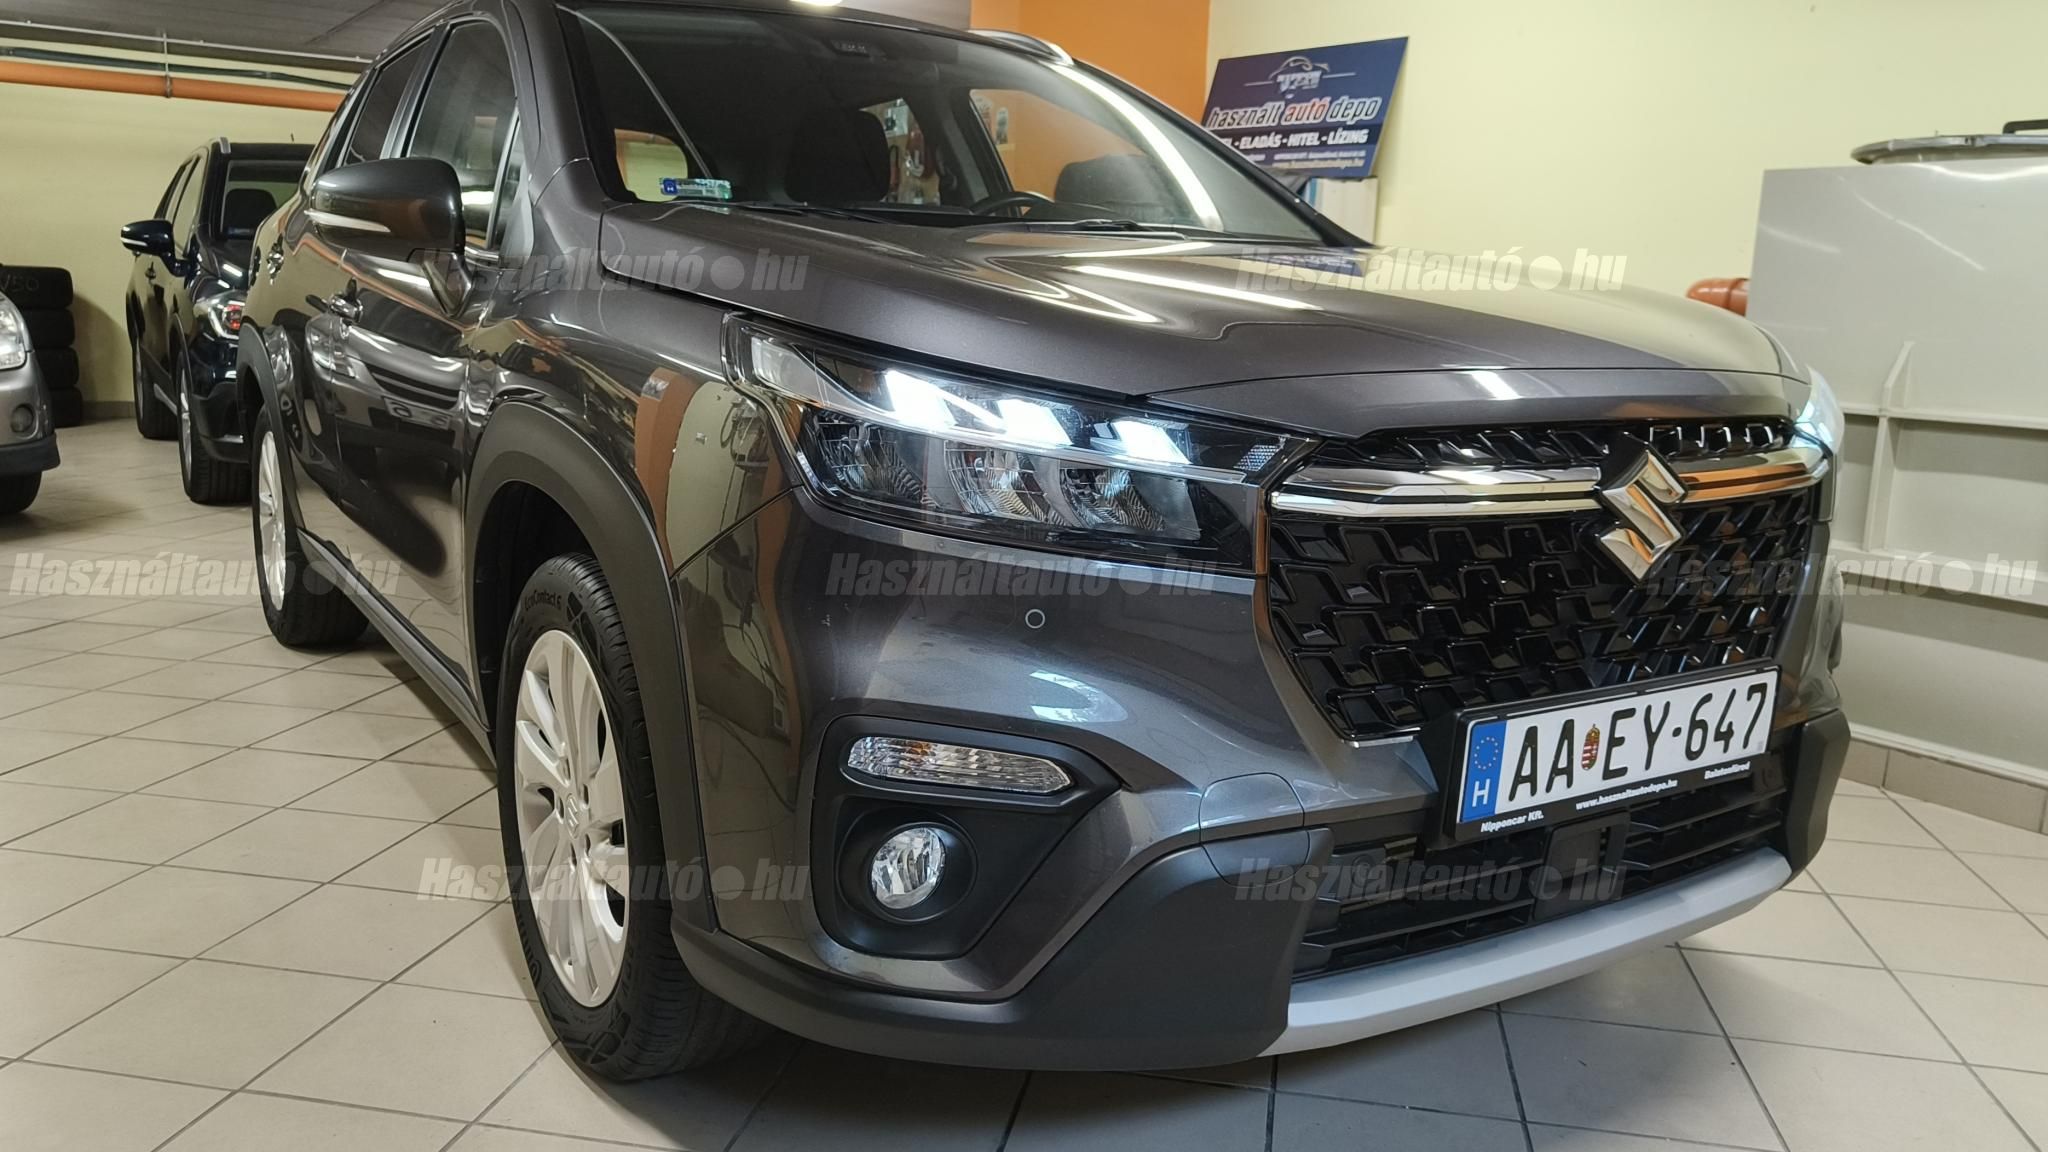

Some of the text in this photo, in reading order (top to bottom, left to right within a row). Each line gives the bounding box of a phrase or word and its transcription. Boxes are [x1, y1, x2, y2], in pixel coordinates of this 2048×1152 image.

[1205, 95, 1382, 130] használt autó depo
[1239, 130, 1282, 150] ELADÁS
[1287, 131, 1321, 147] HITEL
[1327, 127, 1369, 145] LÍZING
[1508, 718, 1575, 802] AA
[1472, 778, 1491, 808] H
[1480, 815, 1527, 833] Nipponcar
